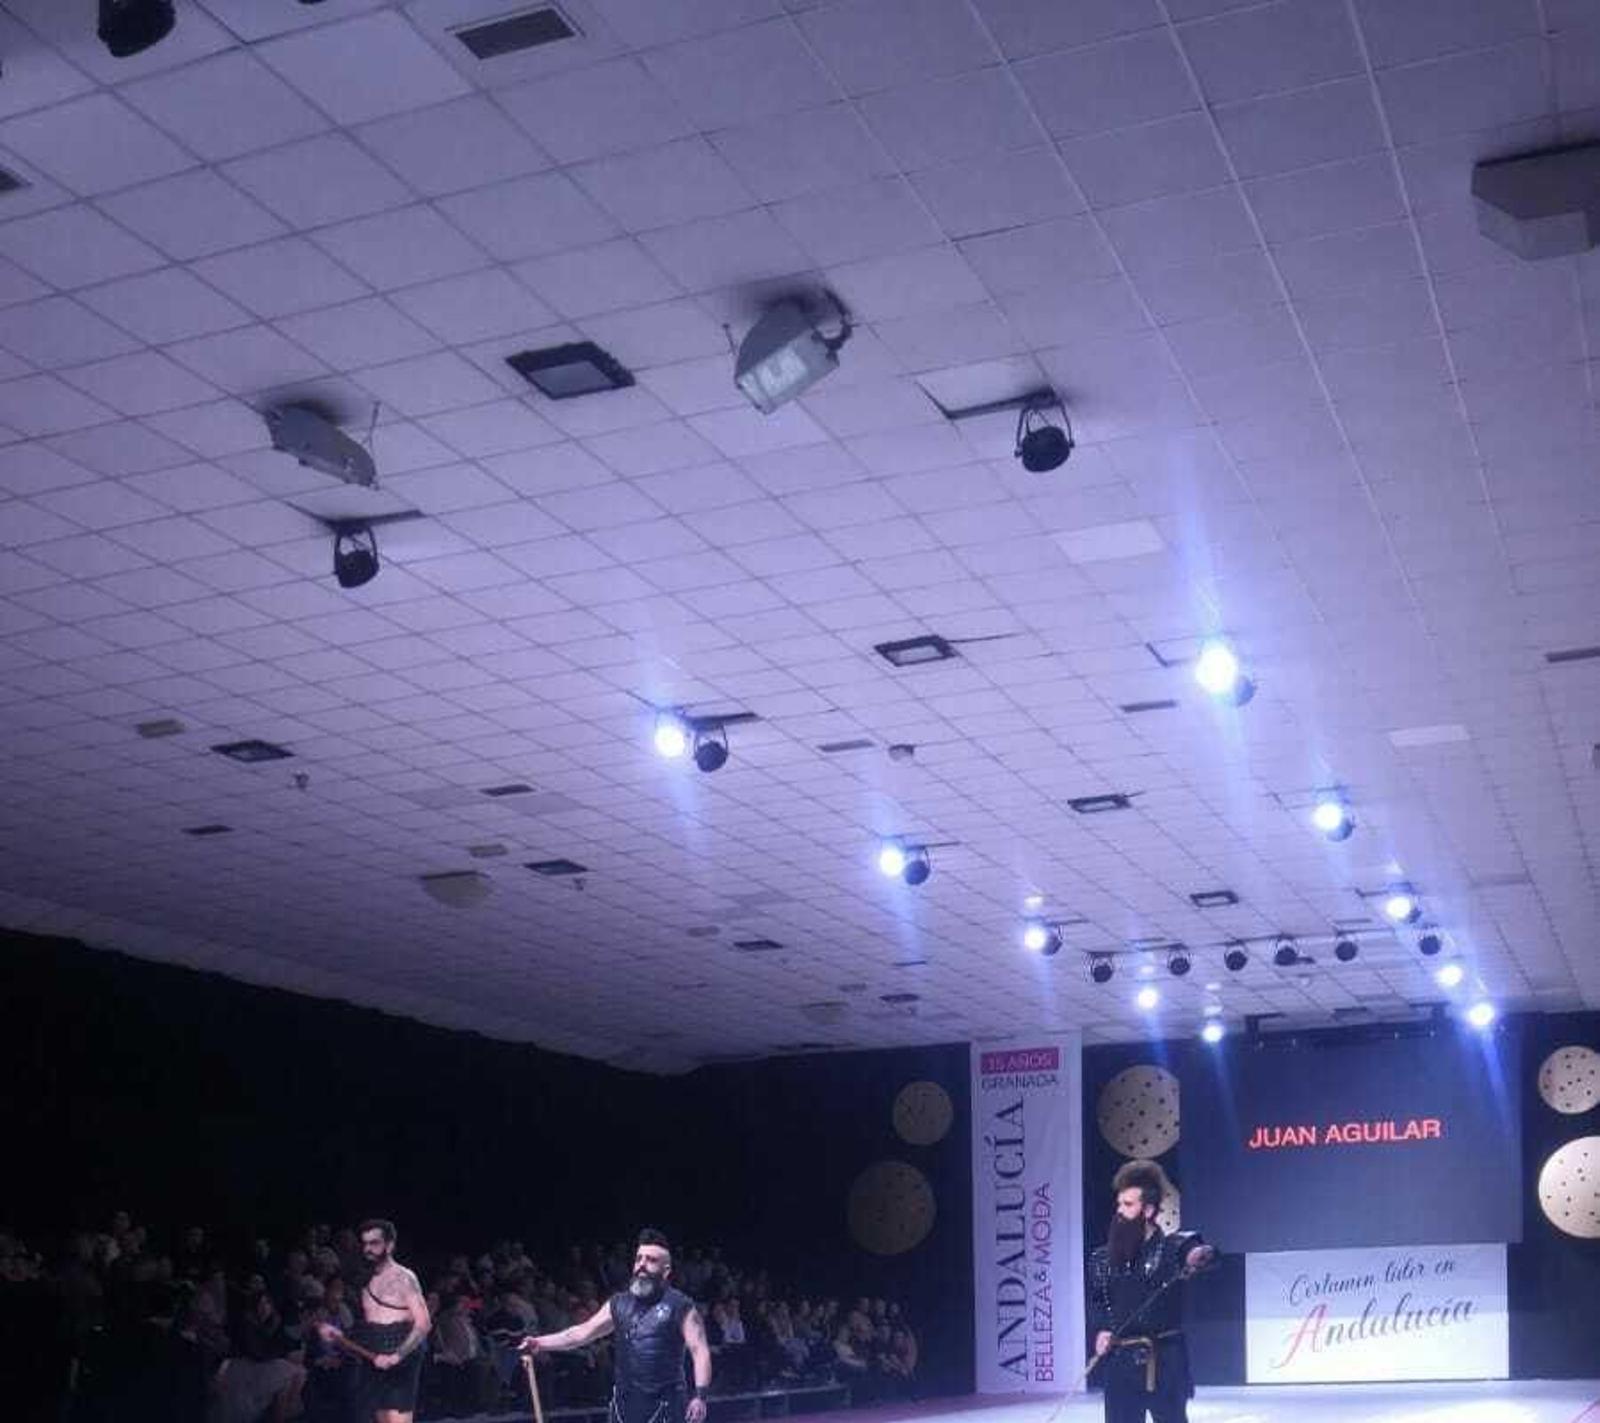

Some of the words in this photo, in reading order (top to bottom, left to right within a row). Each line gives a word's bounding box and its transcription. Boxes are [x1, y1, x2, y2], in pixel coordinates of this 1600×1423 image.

[982, 1073, 1058, 1091] GRANADA
[1249, 1126, 1317, 1148] JUAN
[1324, 1119, 1441, 1144] AGUILAR
[985, 1096, 1028, 1381] ANDALUCÍA
[1031, 1183, 1052, 1264] MODA
[1034, 1267, 1050, 1282] &
[1034, 1284, 1053, 1381] BELLEZA
